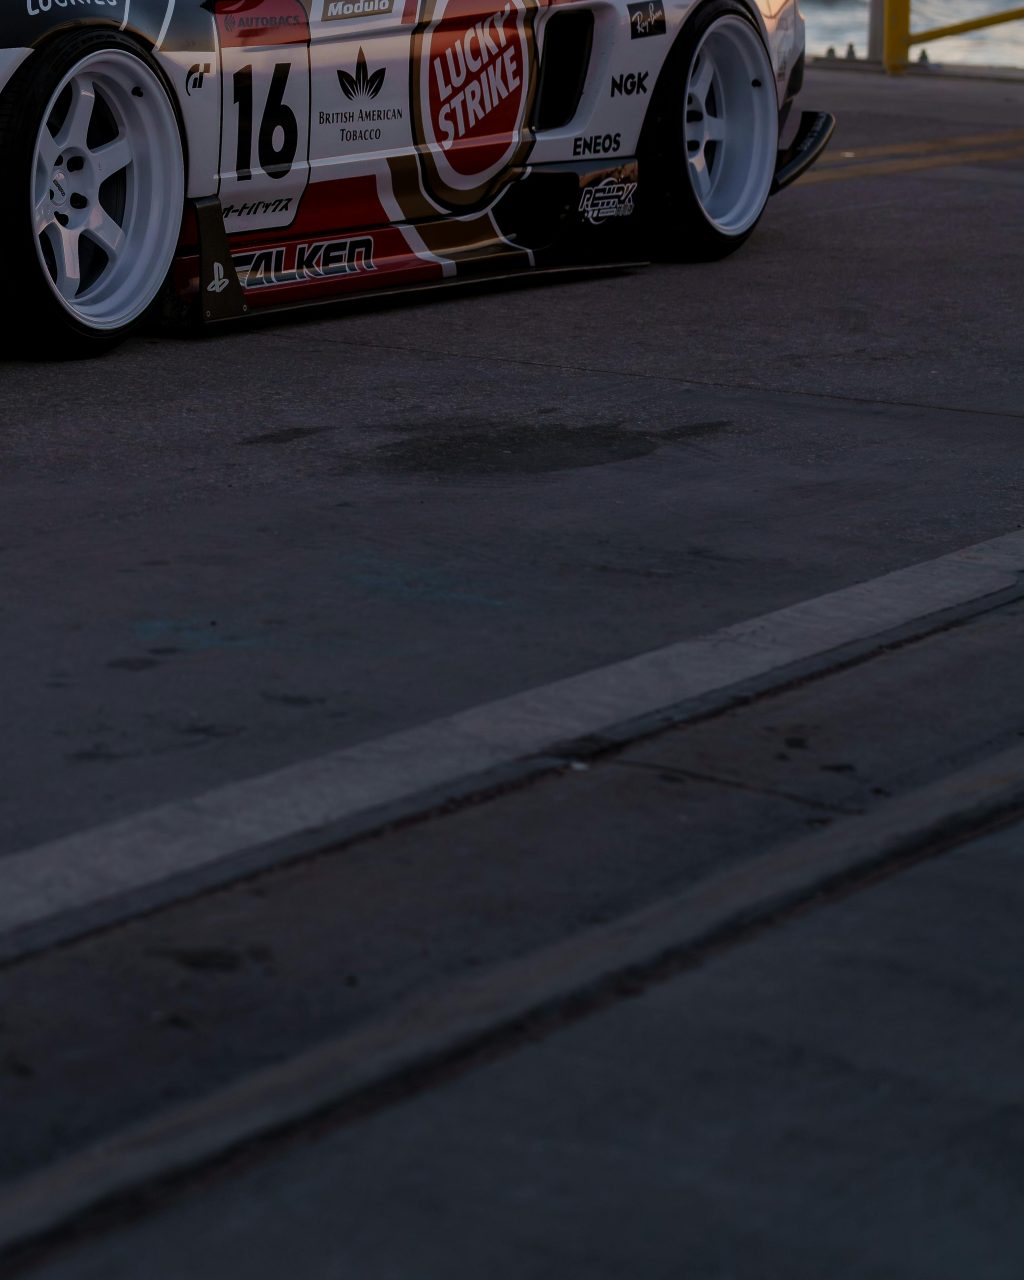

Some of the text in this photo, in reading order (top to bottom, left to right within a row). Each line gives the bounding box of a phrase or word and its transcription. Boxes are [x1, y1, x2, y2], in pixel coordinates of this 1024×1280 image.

[238, 14, 300, 28] AUTOBACS
[433, 2, 511, 103] LUCKY
[437, 44, 521, 151] STRIKE
[610, 71, 649, 98] NGK
[233, 62, 298, 182] 16
[319, 107, 403, 125] BRITISH AMERICAN
[339, 127, 381, 142] TOBACCO
[573, 132, 622, 156] ENEOS
[231, 235, 378, 290] FALKEN
